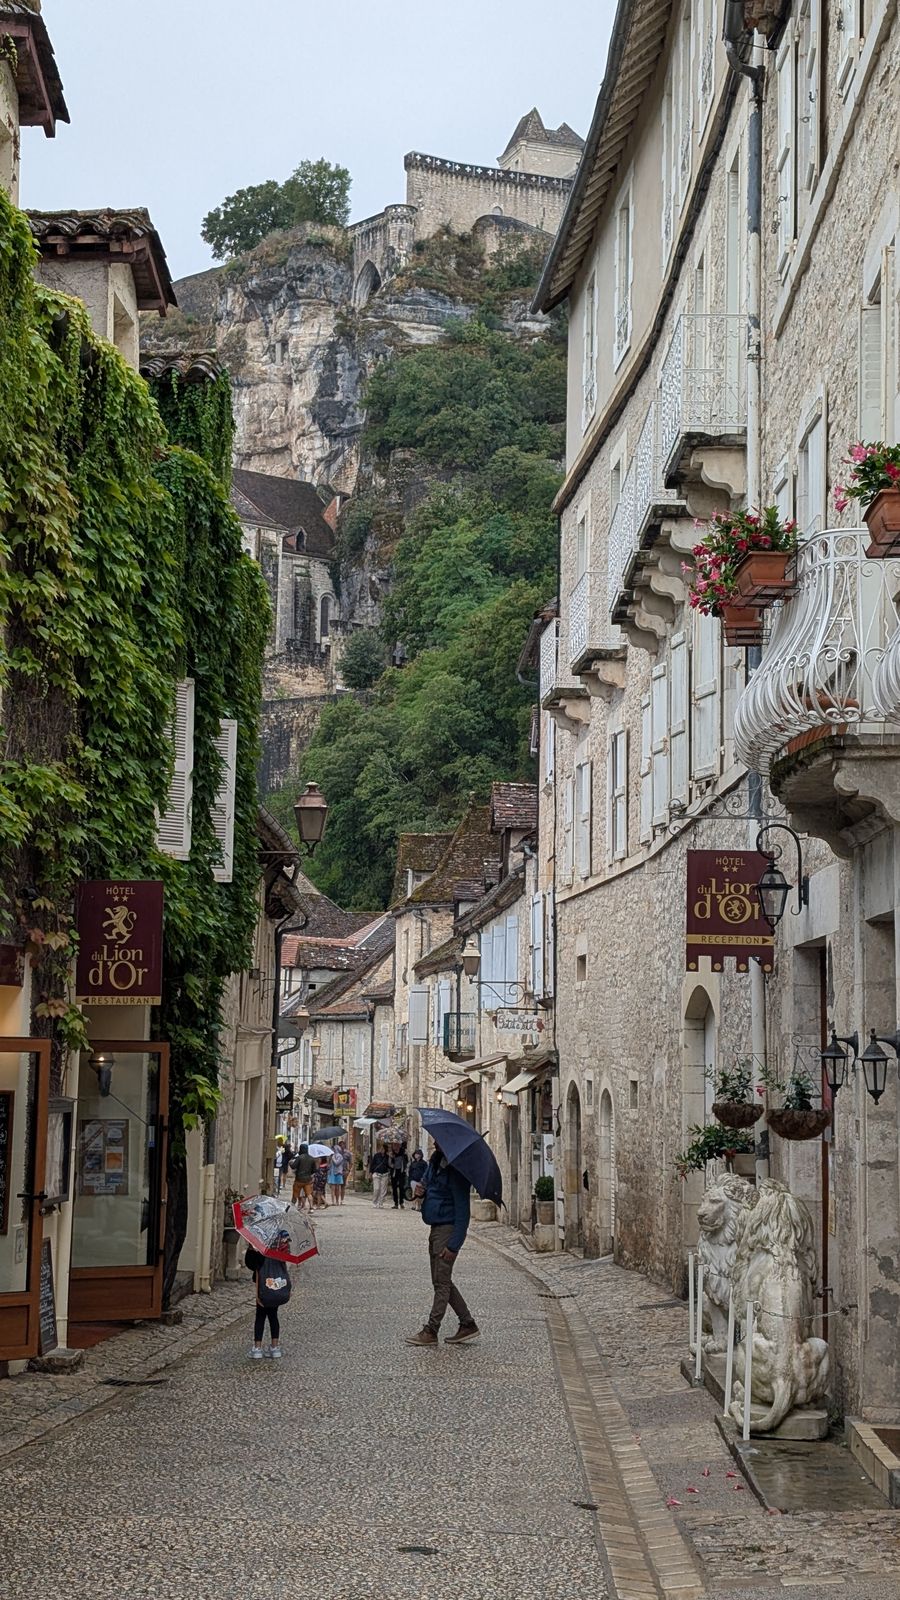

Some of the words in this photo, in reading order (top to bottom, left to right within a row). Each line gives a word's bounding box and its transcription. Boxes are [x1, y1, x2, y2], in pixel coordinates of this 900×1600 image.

[715, 856, 745, 866] HÔTEL
[106, 885, 135, 895] HÔTEL
[701, 936, 760, 944] RECEPTION
[103, 944, 143, 961] Lion
[88, 960, 148, 990] d'Or
[91, 997, 156, 1005] RESTAURANT
